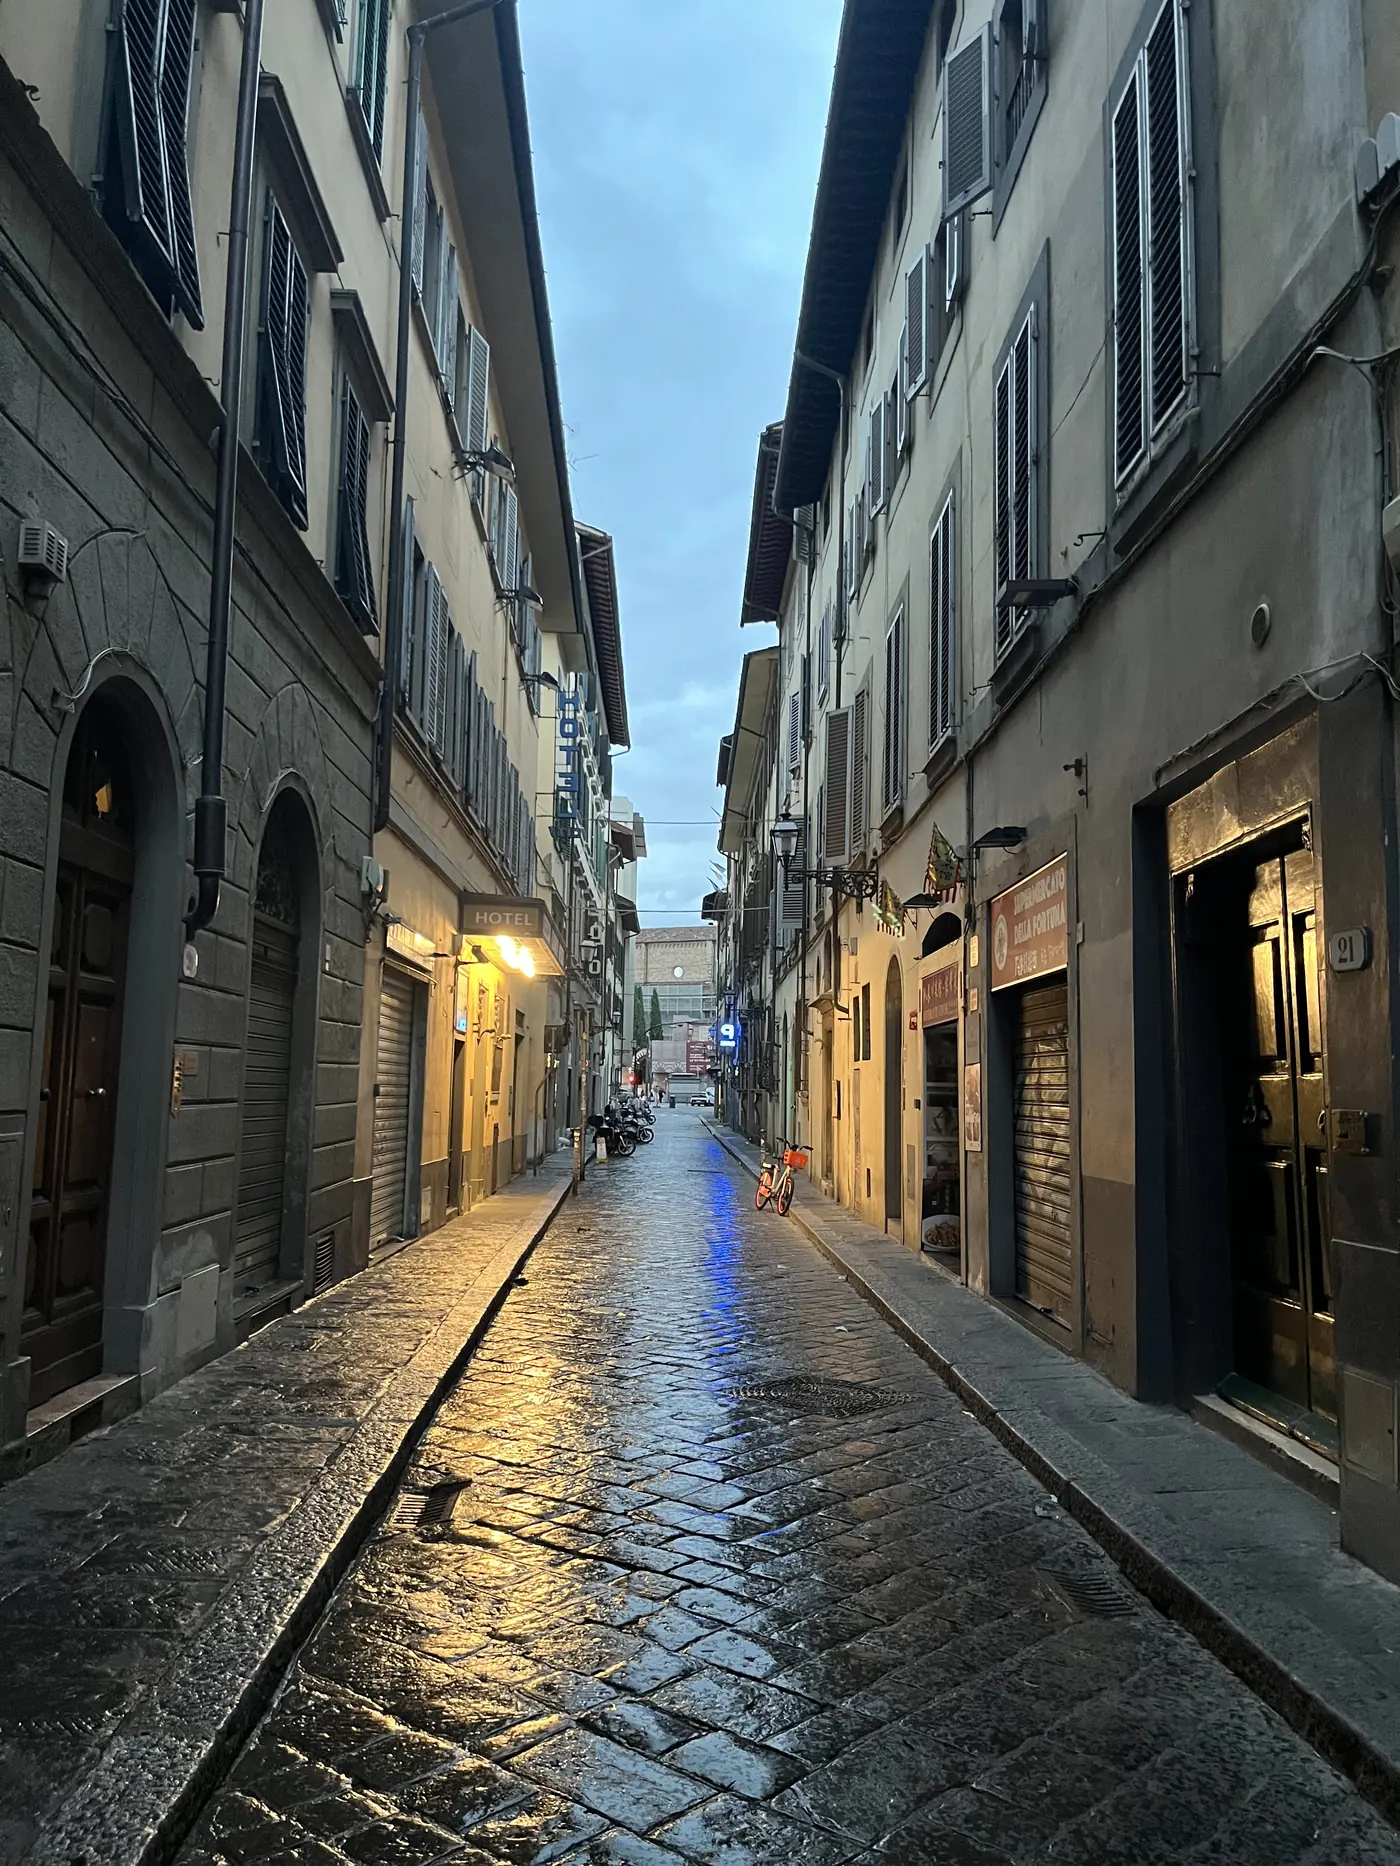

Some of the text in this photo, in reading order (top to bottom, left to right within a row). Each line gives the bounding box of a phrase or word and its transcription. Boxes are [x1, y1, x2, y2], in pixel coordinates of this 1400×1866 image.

[1013, 867, 1065, 916] SUPERMERCATO
[475, 911, 533, 926] HOTEL
[1013, 918, 1032, 946] DELLA
[1032, 901, 1066, 938] FORTUNA
[1338, 936, 1354, 963] 21
